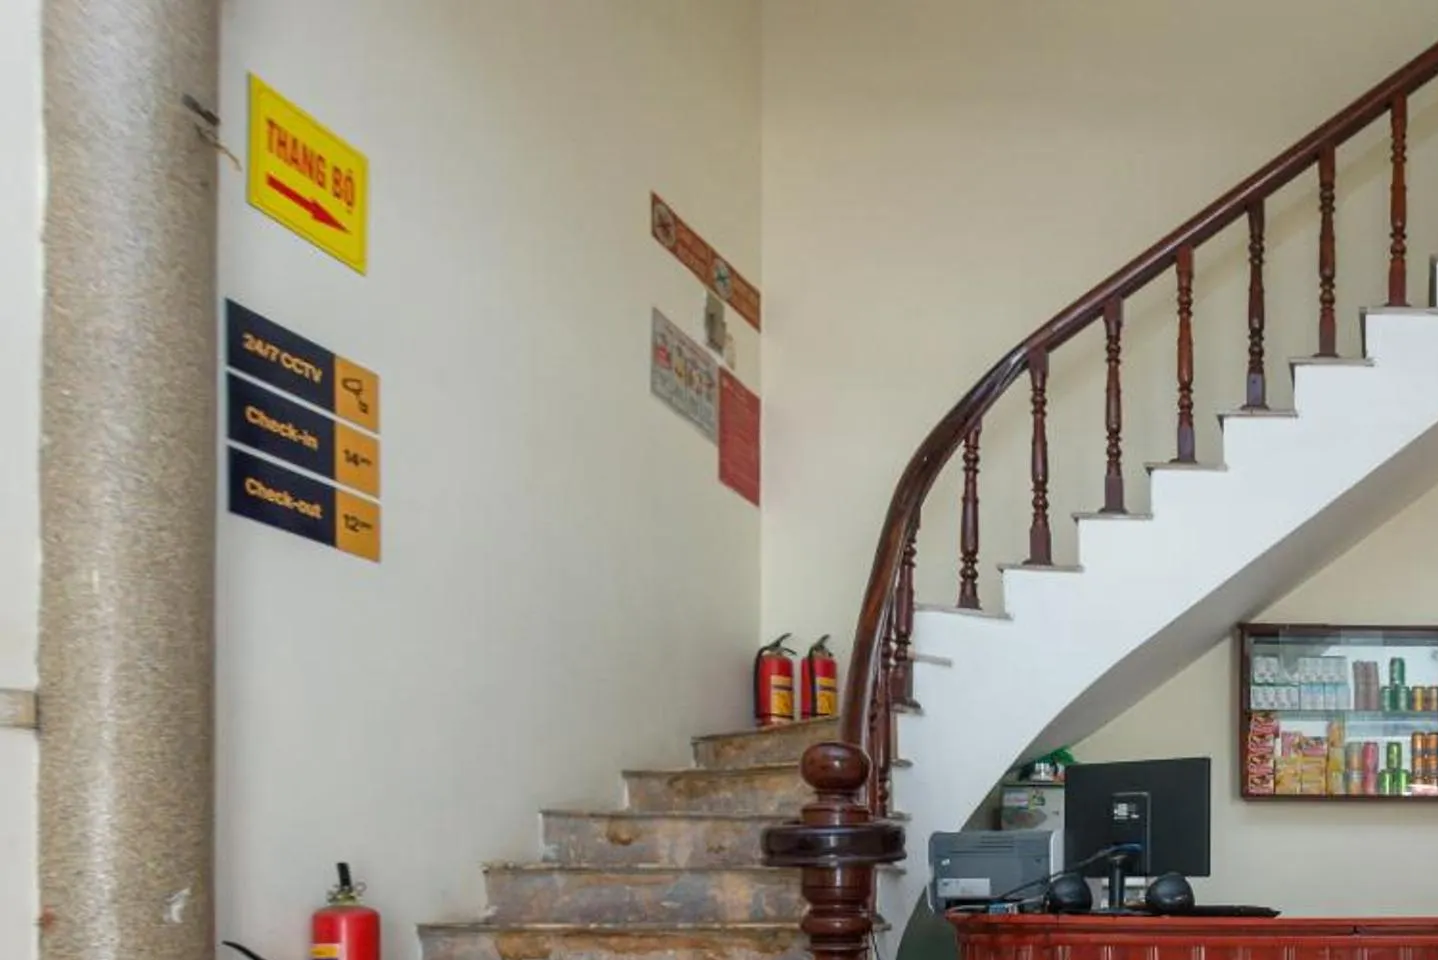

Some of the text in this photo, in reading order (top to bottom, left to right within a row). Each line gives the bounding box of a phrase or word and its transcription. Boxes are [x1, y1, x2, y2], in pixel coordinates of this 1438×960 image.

[266, 118, 355, 215] THANG BỘ
[280, 351, 323, 384] CCTV
[245, 405, 319, 450] Check-in
[244, 477, 323, 519] Check-out
